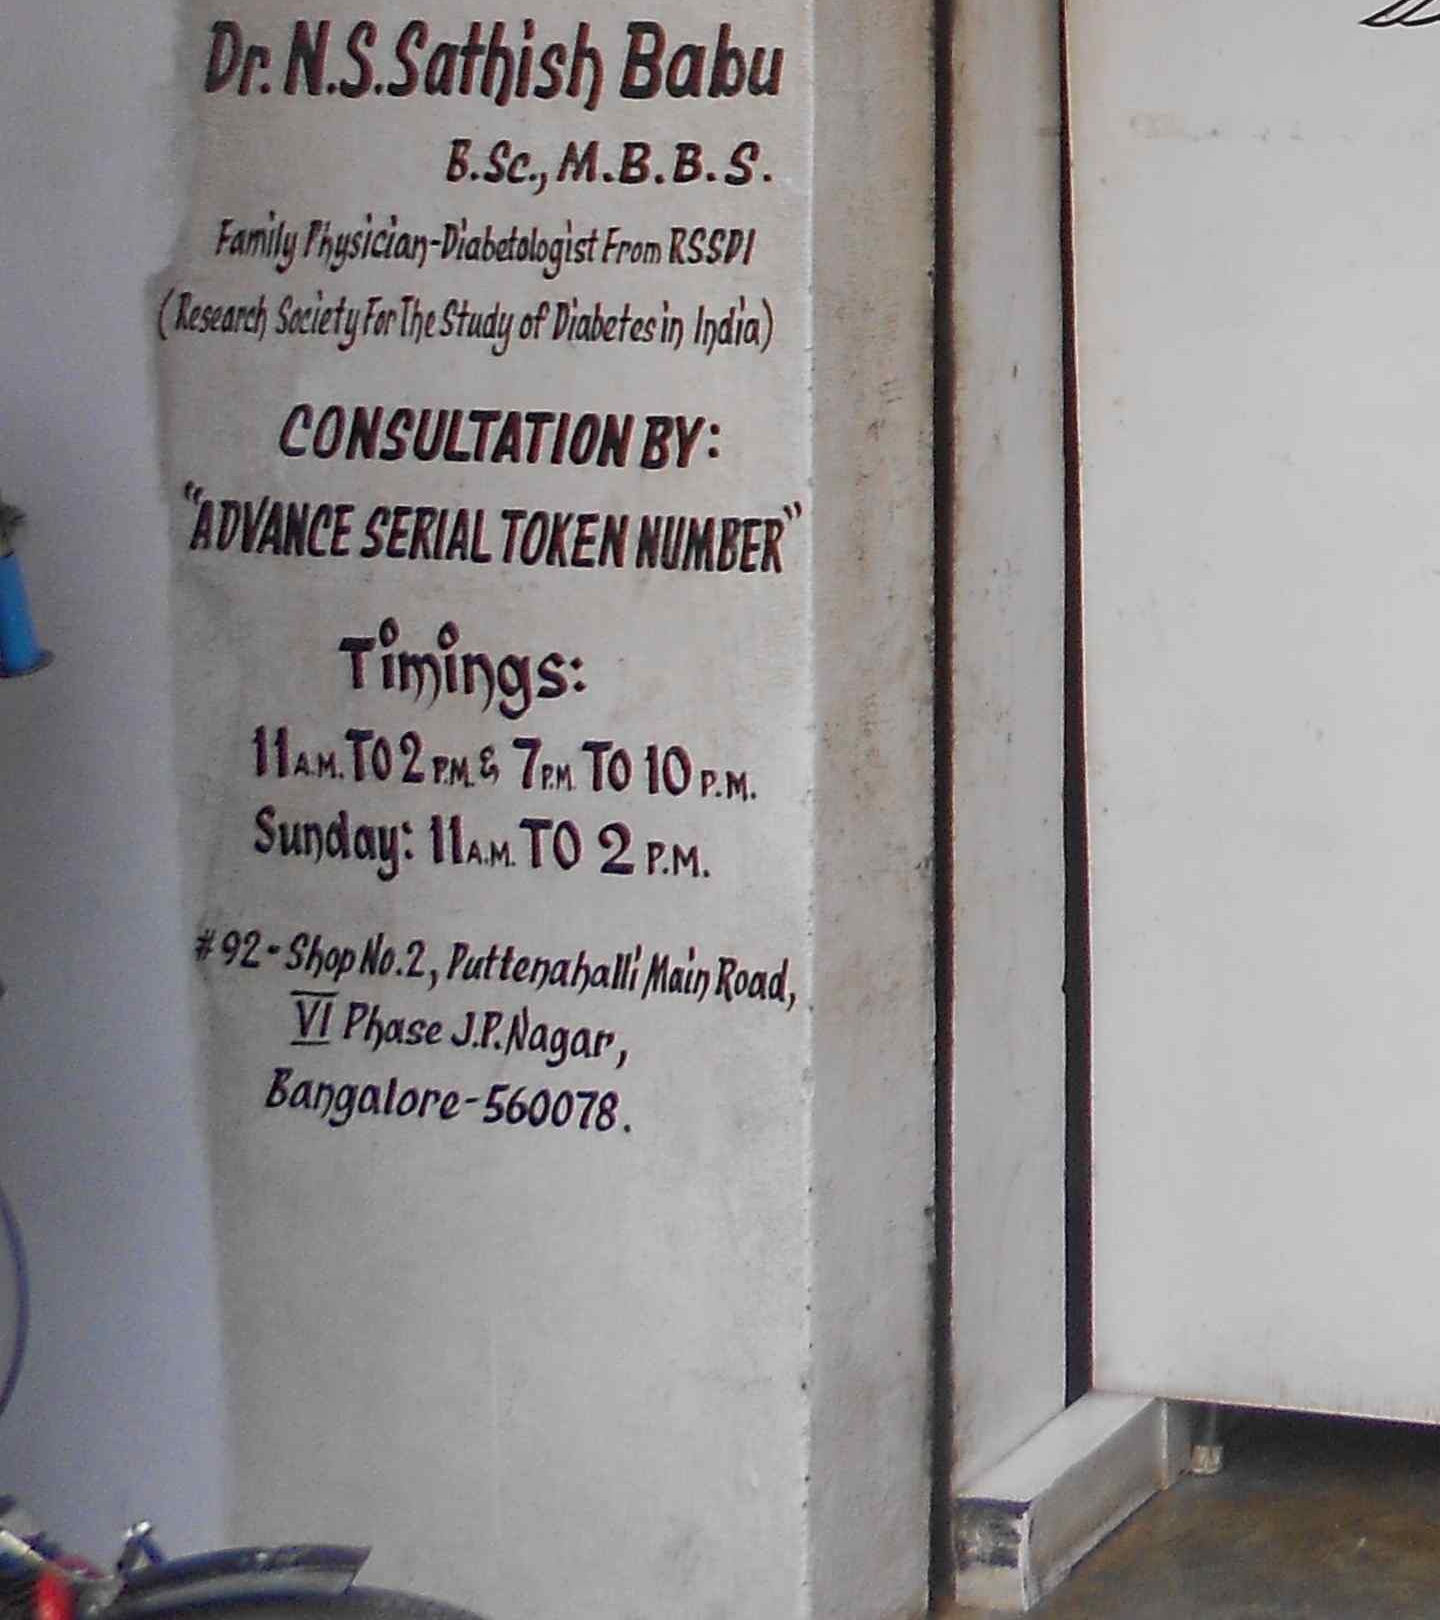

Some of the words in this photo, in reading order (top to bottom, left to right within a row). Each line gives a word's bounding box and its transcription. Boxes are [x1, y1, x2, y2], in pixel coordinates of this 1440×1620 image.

[619, 21, 784, 100] Babu
[445, 138, 548, 196] B.Sc.,
[214, 210, 298, 275] Family
[601, 226, 662, 264] From
[668, 227, 756, 266] RSSDI
[156, 287, 267, 342] (Research
[274, 289, 361, 352] Society
[362, 296, 397, 336] For
[399, 295, 436, 344] The
[440, 298, 515, 357] Study
[518, 300, 551, 340] of
[551, 297, 657, 343] Diabetes
[660, 300, 684, 351] in
[693, 295, 774, 356] India)
[278, 403, 634, 468] CONSULTATION
[639, 415, 720, 470] BY:
[359, 505, 492, 564] SERIAL
[500, 509, 629, 568] TOKEN
[337, 616, 586, 721] Timings:
[344, 728, 392, 783] TO
[479, 745, 500, 781] &
[580, 740, 631, 792] TO
[645, 744, 691, 796] 10
[253, 806, 413, 881] Sunday:
[518, 817, 581, 871] TO
[445, 941, 640, 994] Puttenahalli
[641, 946, 710, 1002] Main
[714, 956, 796, 1011] Road,
[289, 989, 338, 1047] VI
[342, 1001, 443, 1052] Phase
